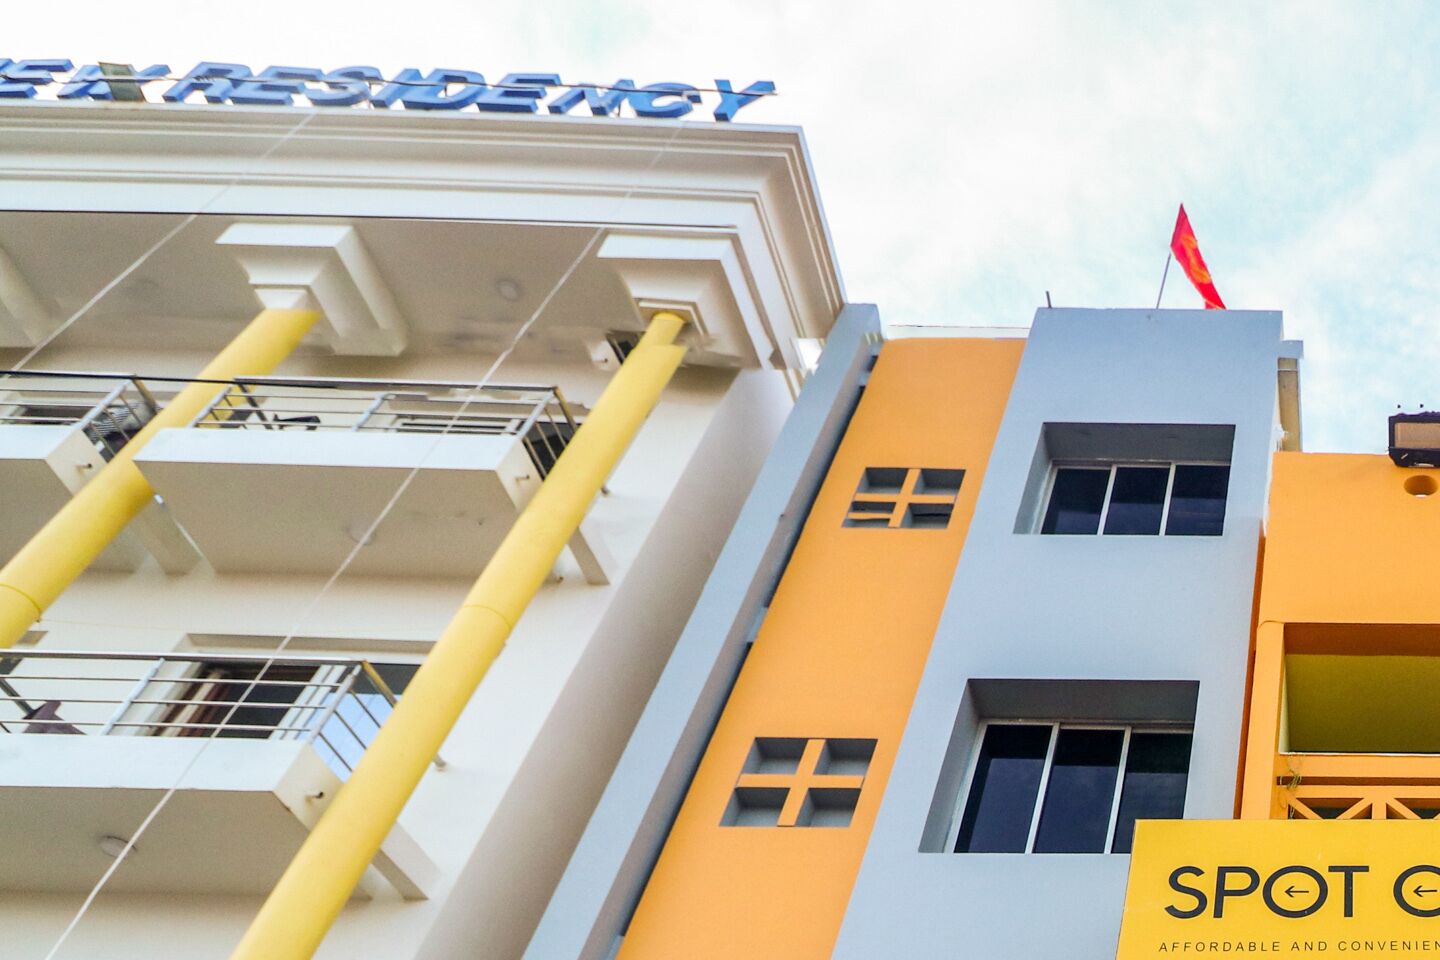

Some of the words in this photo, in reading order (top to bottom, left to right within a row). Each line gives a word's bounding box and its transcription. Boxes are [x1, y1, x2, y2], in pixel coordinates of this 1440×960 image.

[162, 61, 778, 122] RESIDENCY
[1164, 865, 1370, 919] SPOT
[1158, 941, 1281, 952] AFFORDABLE
[1290, 940, 1328, 952] AND
